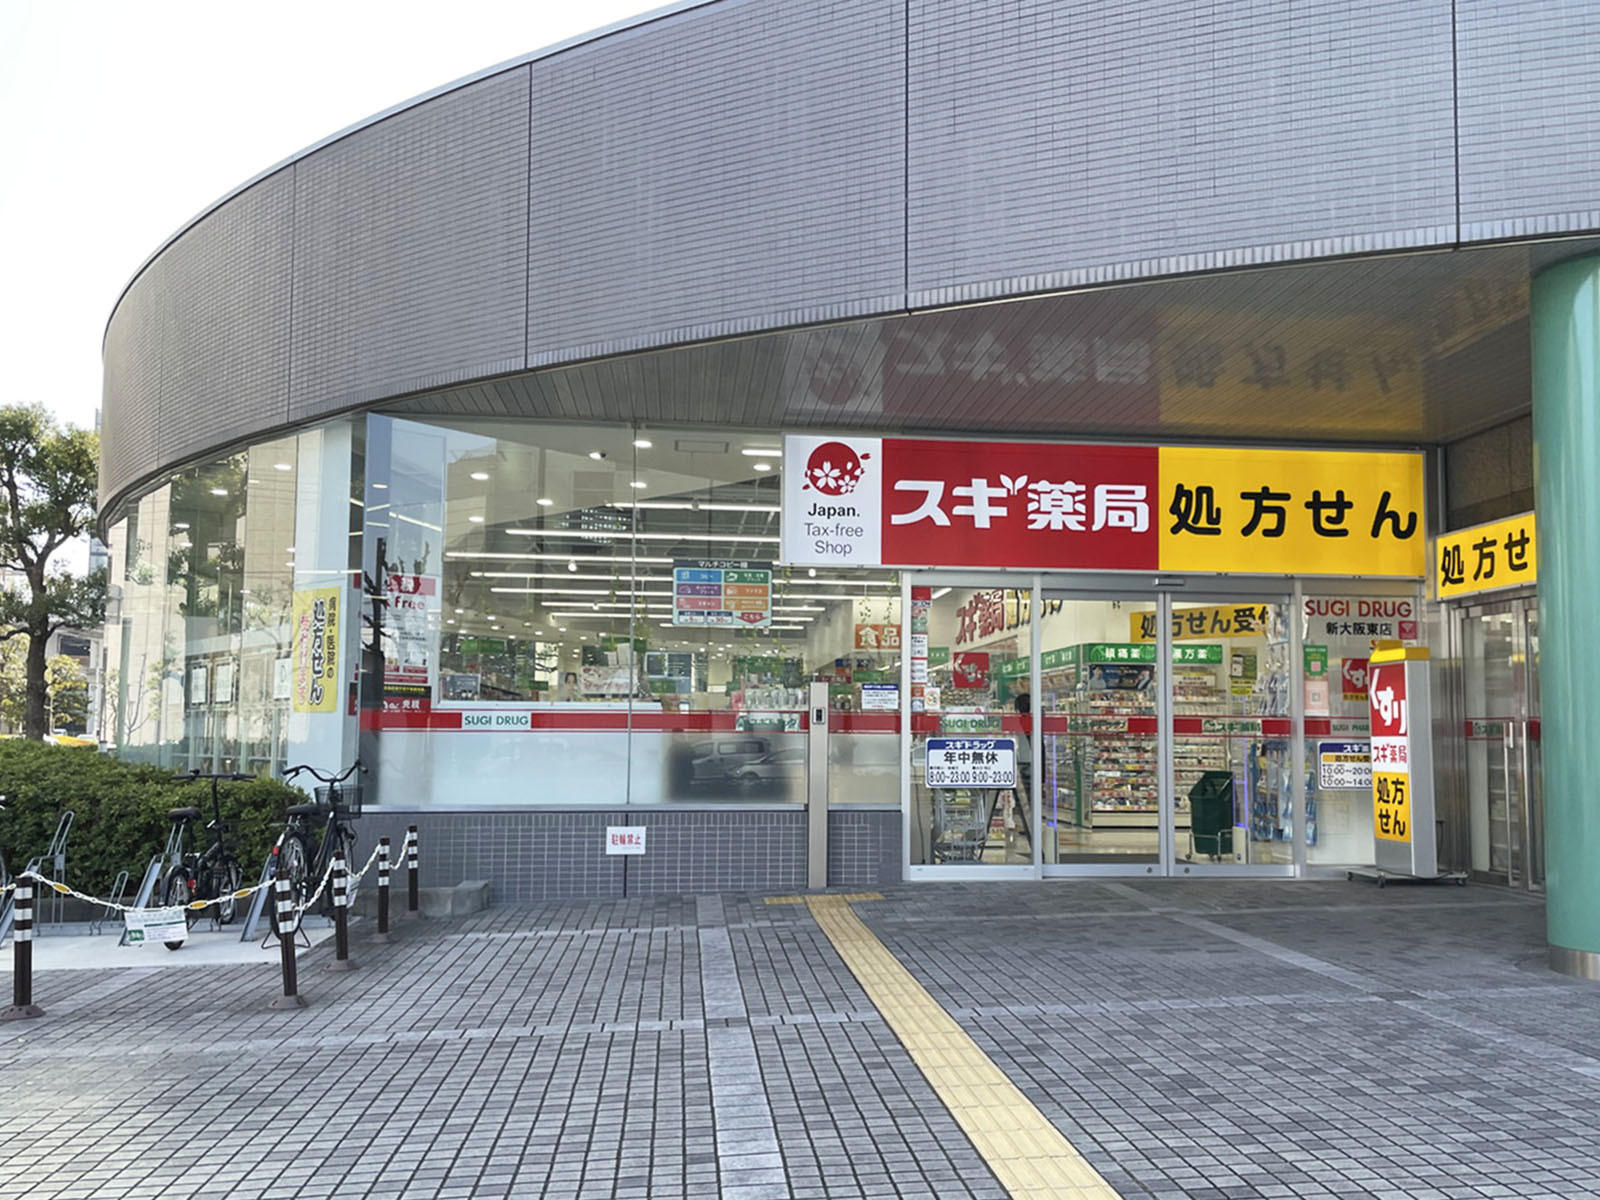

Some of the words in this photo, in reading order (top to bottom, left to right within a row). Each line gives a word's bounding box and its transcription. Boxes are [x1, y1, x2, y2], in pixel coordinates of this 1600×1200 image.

[807, 502, 861, 518] Japan.
[890, 473, 1150, 533] スギ薬局
[1169, 483, 1418, 539] 処方せん
[804, 522, 864, 538] Tax-free
[814, 540, 853, 557] Shop
[1439, 529, 1531, 588] 処方せ
[1304, 599, 1350, 616] SUGI
[1358, 600, 1412, 618] DRUG
[858, 626, 900, 647] 食品
[1326, 621, 1392, 636] 新大阪東店
[1370, 667, 1407, 735] くすり
[464, 715, 493, 726] SUGI
[496, 716, 529, 726] DRUG
[944, 751, 998, 764] 年中無休
[1373, 743, 1408, 764] スギ薬局
[1377, 777, 1405, 806] 処方
[1378, 809, 1406, 836] せん
